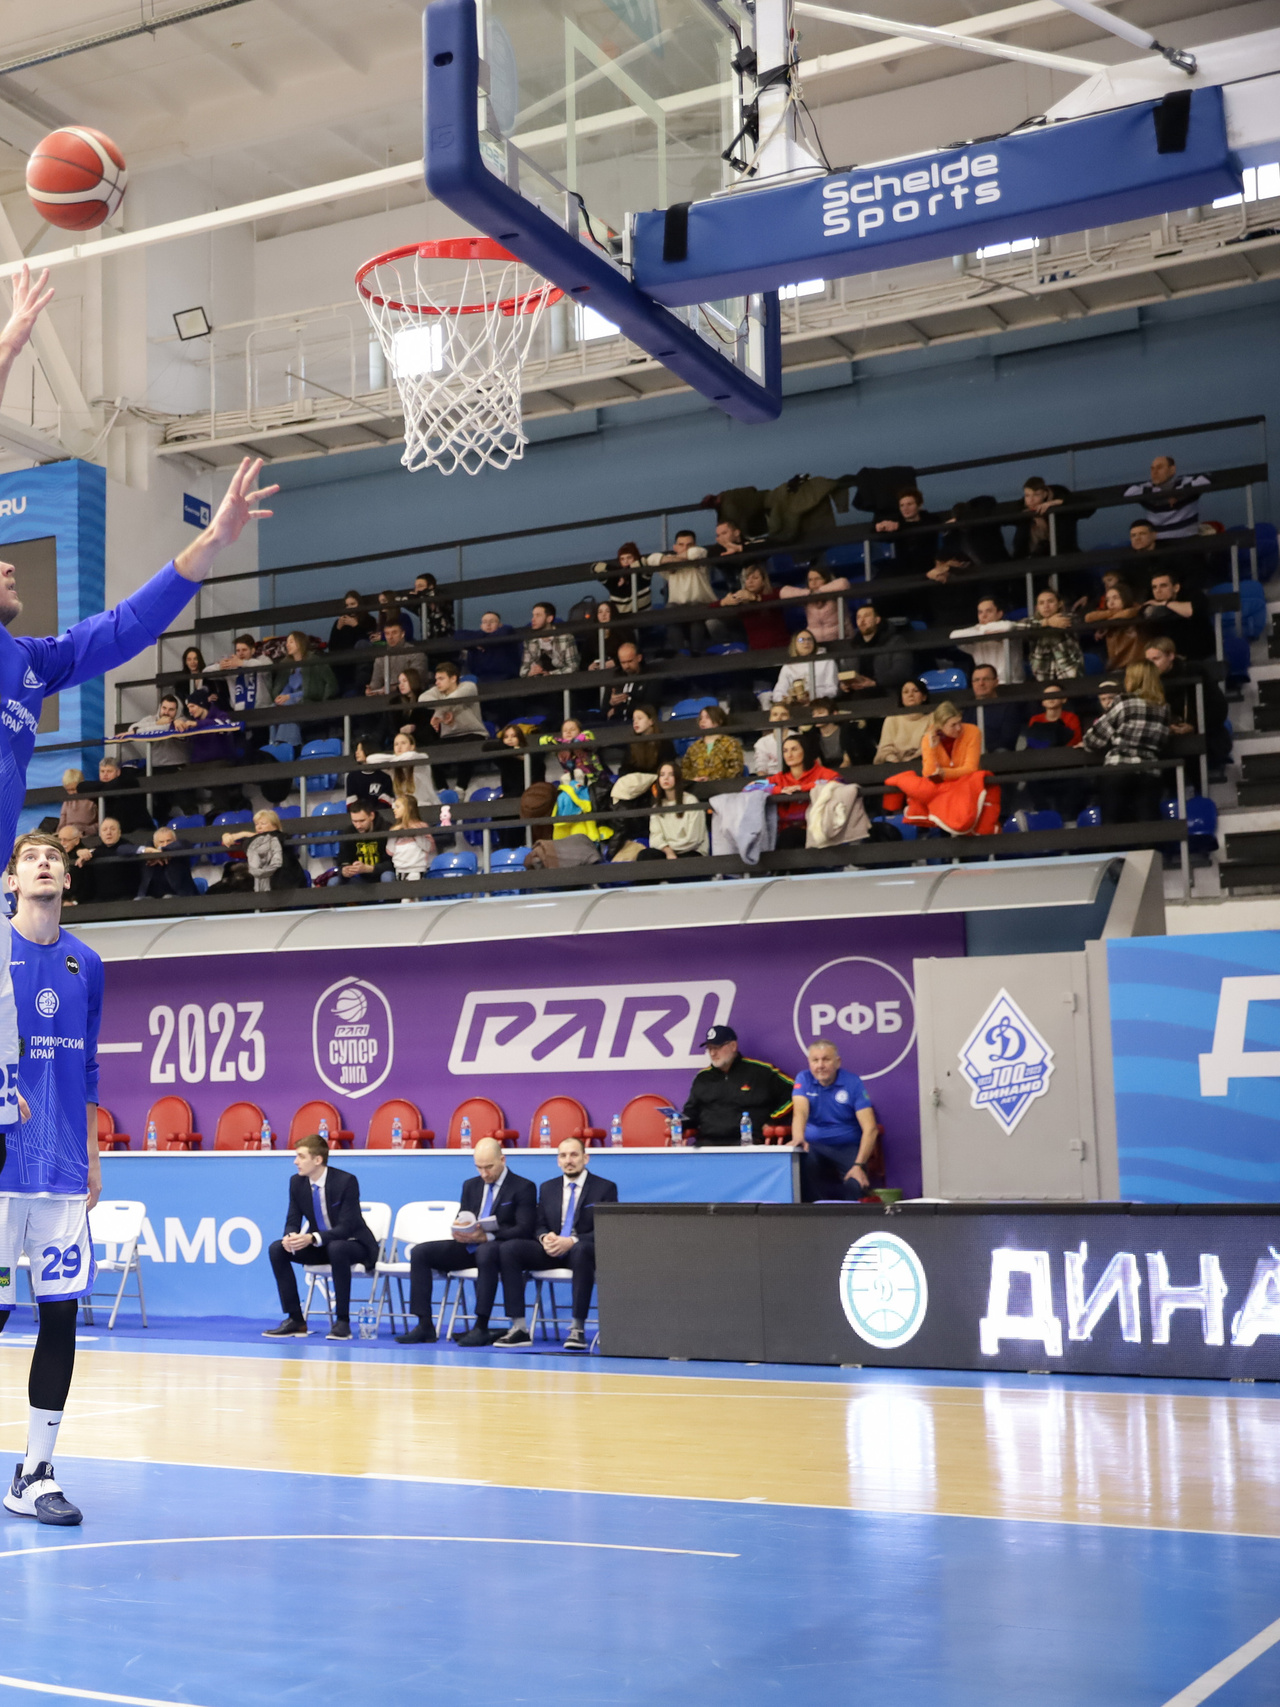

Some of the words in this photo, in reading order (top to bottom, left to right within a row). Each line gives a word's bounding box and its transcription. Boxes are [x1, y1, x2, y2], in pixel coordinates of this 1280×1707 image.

[823, 154, 998, 209] Schelde
[823, 180, 1000, 237] Sports
[461, 992, 720, 1062] PARI
[810, 1001, 903, 1035] РФБ
[30, 1046, 55, 1059] КРАЙ
[329, 1038, 378, 1065] СУПЕР
[339, 1066, 368, 1084] ЛИГА
[977, 1080, 1043, 1102] ДИНАМО
[42, 1244, 82, 1282] 29
